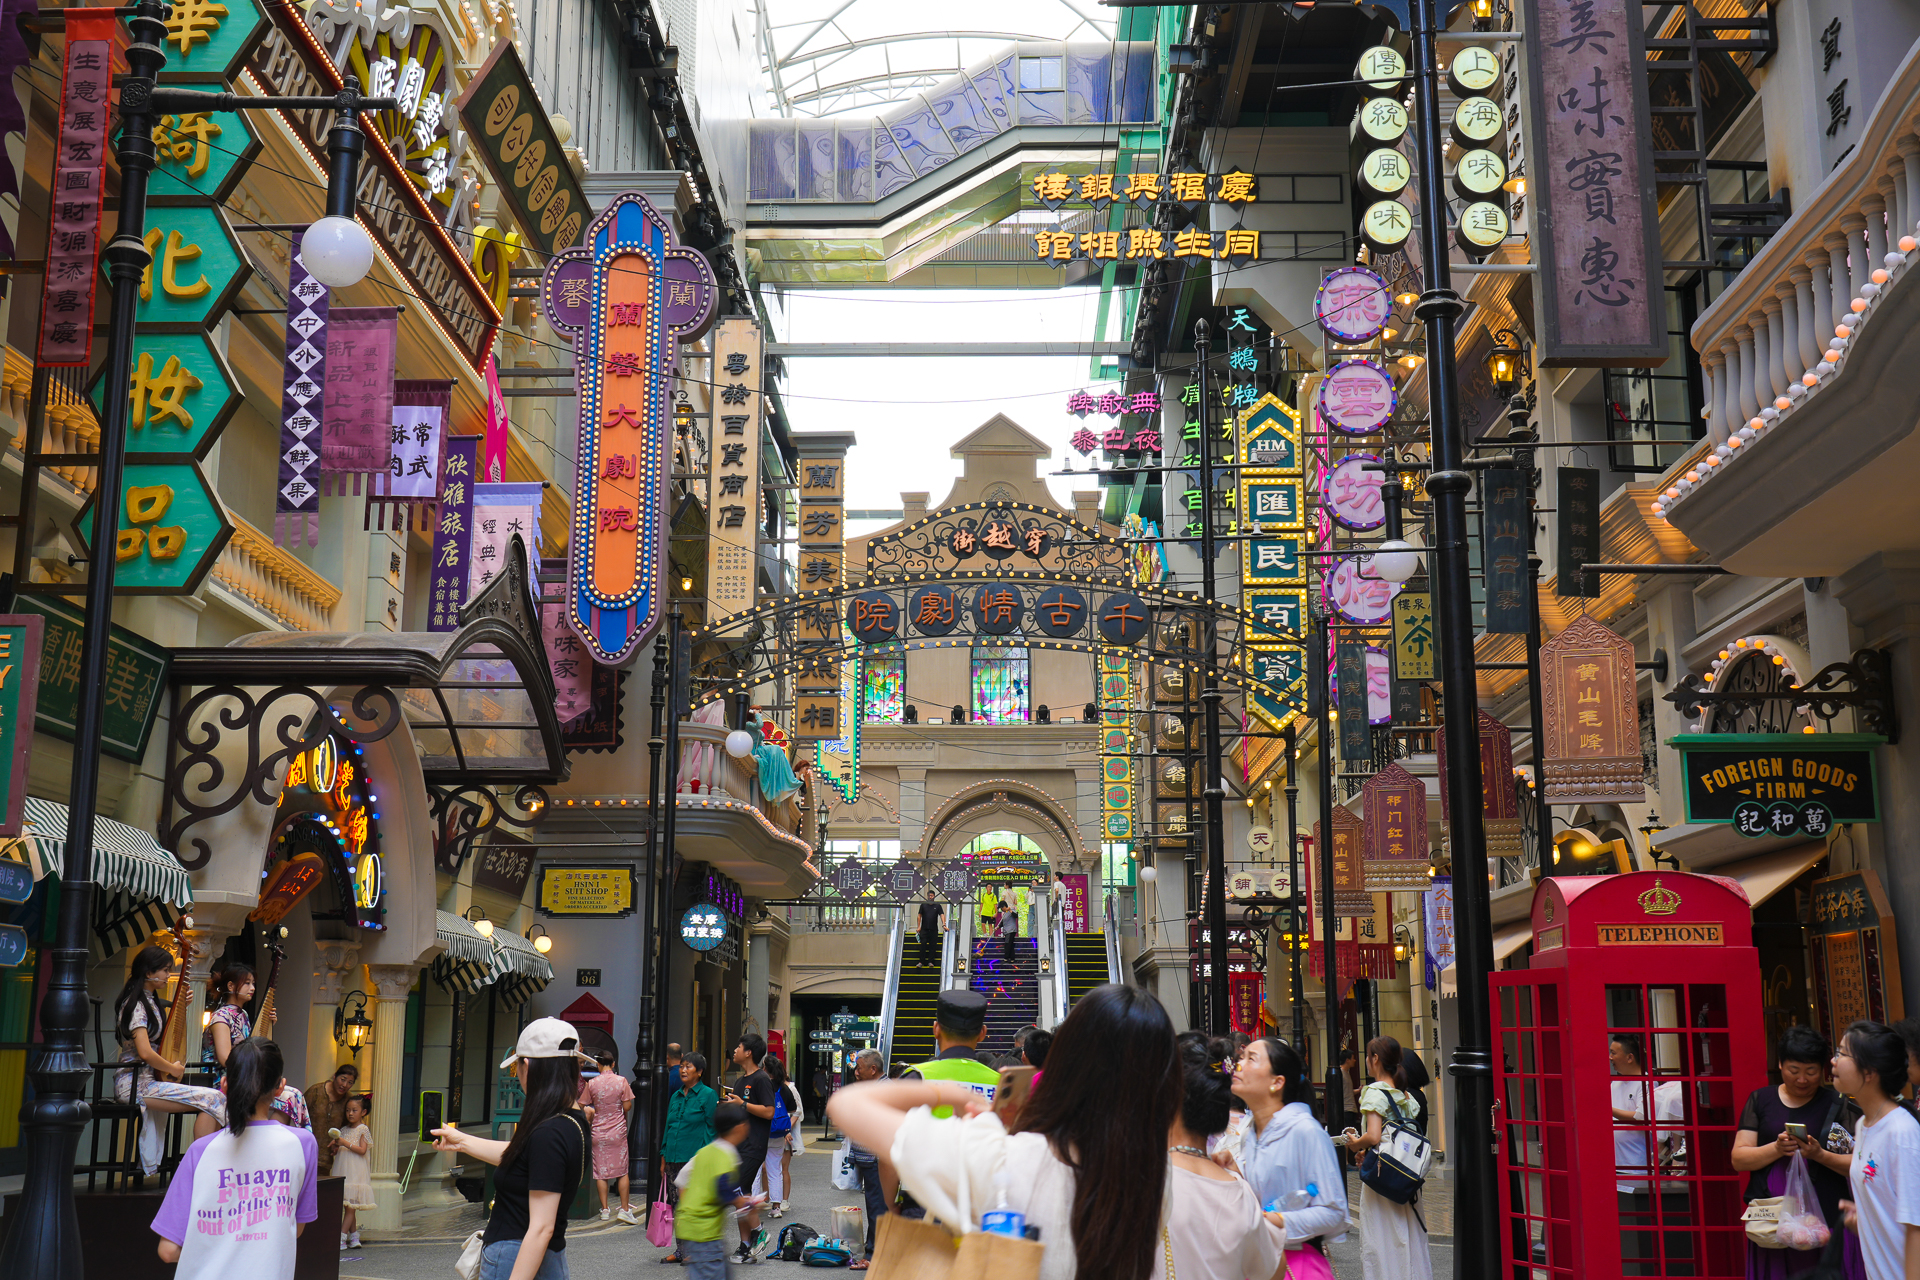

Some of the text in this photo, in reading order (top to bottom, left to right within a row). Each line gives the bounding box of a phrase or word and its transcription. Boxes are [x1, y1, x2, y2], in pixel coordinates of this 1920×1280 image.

[1368, 50, 1406, 229] 傳統風味
[1463, 51, 1503, 234] 上海味道
[407, 228, 485, 356] THEATER
[325, 340, 356, 437] 新品上市
[1228, 309, 1259, 408] 天鵝牌
[599, 302, 645, 532] 蘭馨大劇院
[1256, 439, 1287, 451] HM
[438, 453, 468, 567] 欣雅旅店
[1701, 758, 1857, 794] FOREIGN GOODS
[1756, 782, 1806, 798] FIRM
[1386, 795, 1405, 856] 祁门红茶
[1435, 888, 1455, 957] 久昌水果
[1601, 927, 1719, 942] TELEPHONE
[581, 976, 596, 985] 96
[218, 1168, 290, 1189] Fuayn
